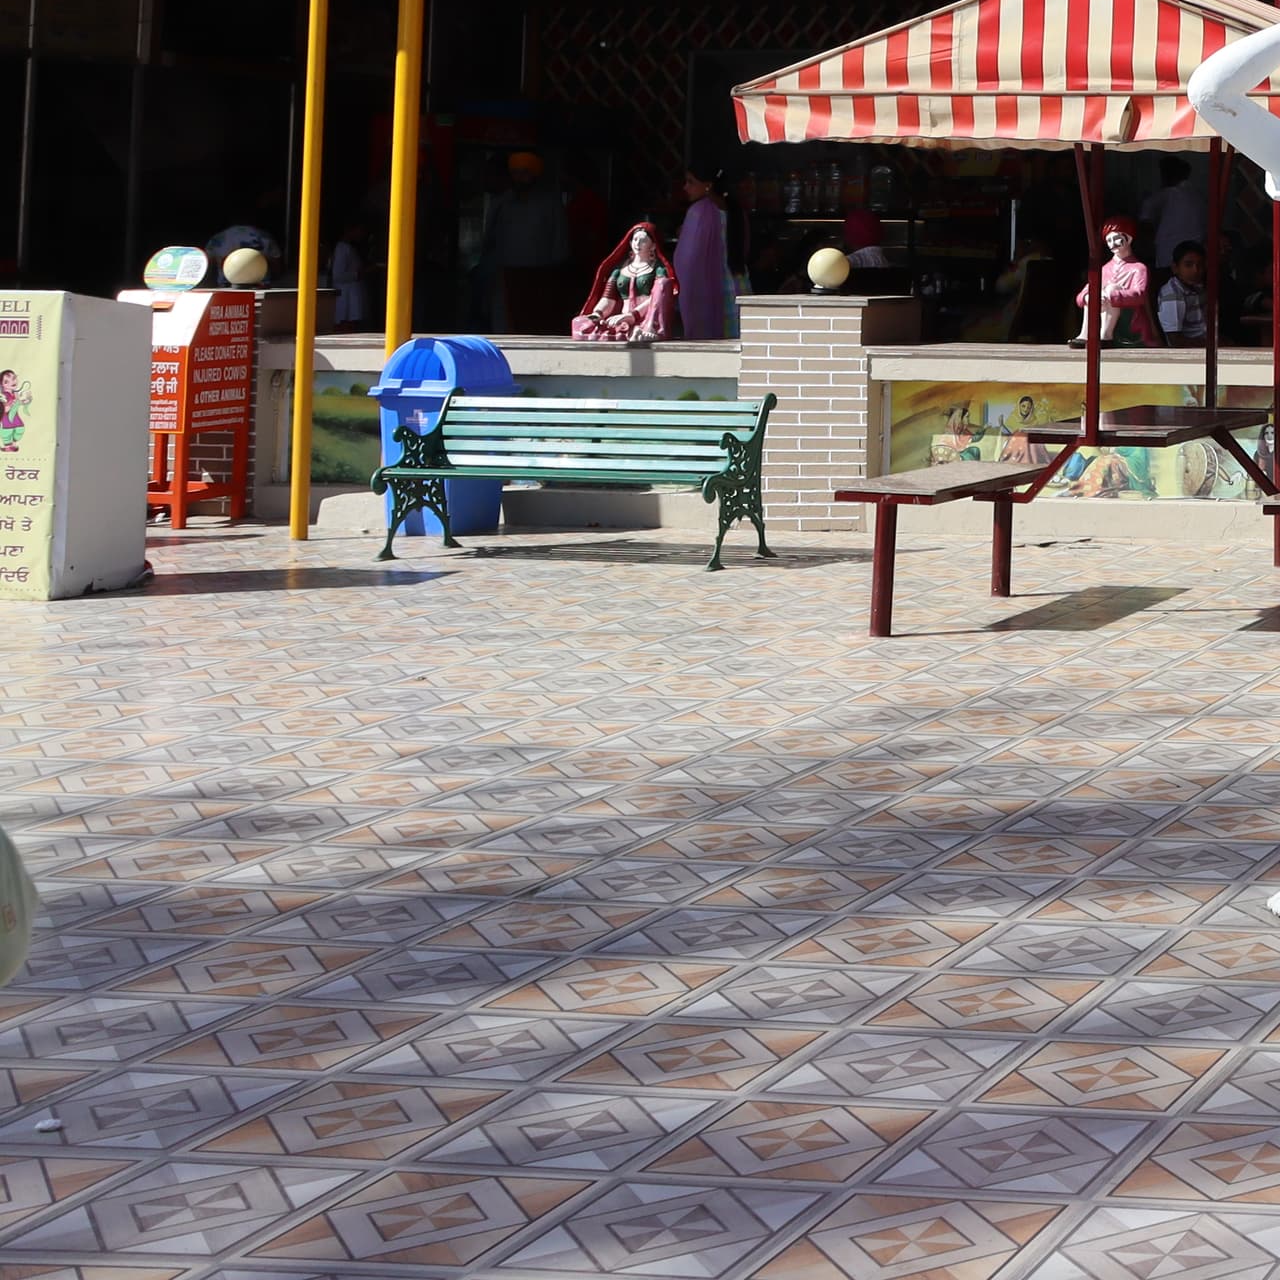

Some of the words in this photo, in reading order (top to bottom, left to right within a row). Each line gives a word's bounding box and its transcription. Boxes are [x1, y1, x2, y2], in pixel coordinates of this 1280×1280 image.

[194, 346, 214, 362] PLEASE
[214, 345, 236, 360] DONATE
[236, 344, 248, 359] FOR
[193, 367, 222, 384] INJURED
[199, 389, 220, 403] OTHER
[220, 387, 246, 401] ANIMALS
